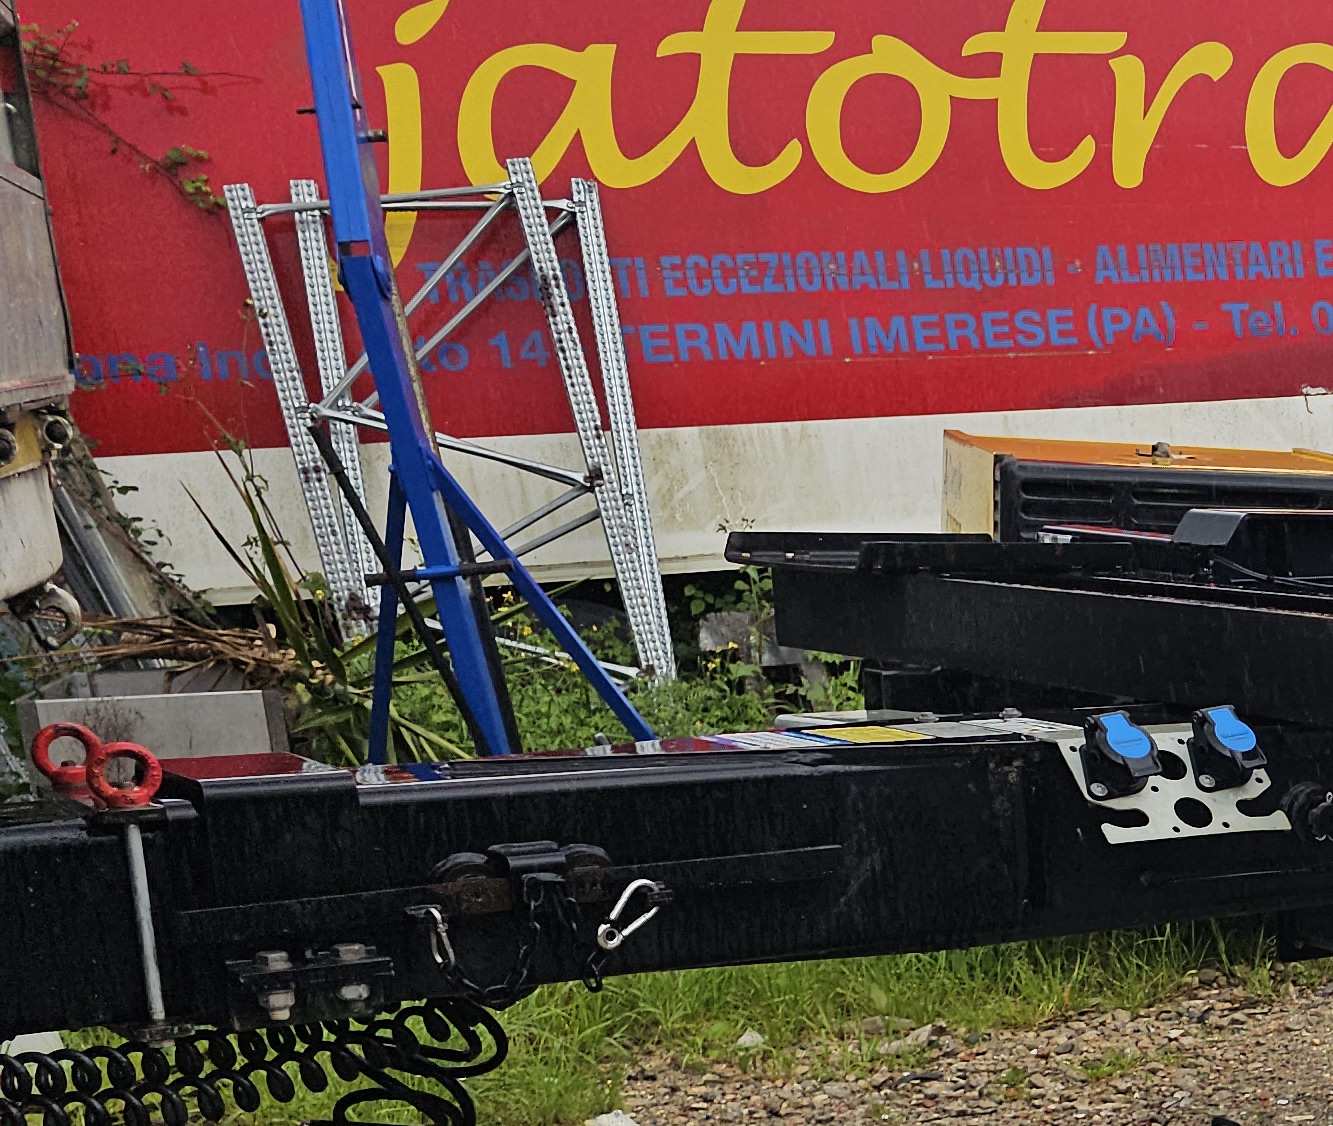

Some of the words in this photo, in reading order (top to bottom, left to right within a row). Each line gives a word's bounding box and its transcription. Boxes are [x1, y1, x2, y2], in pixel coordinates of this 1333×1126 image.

[416, 256, 650, 305] TRASOTI
[660, 251, 909, 297] ECCEZIONALI
[919, 247, 1055, 291] LIQUIDI
[1095, 241, 1304, 284] ALIMENTARI
[74, 352, 178, 388] ona
[849, 308, 1079, 354] IMERESE
[1087, 302, 1175, 349] (PA)
[1220, 302, 1299, 338] Tel.
